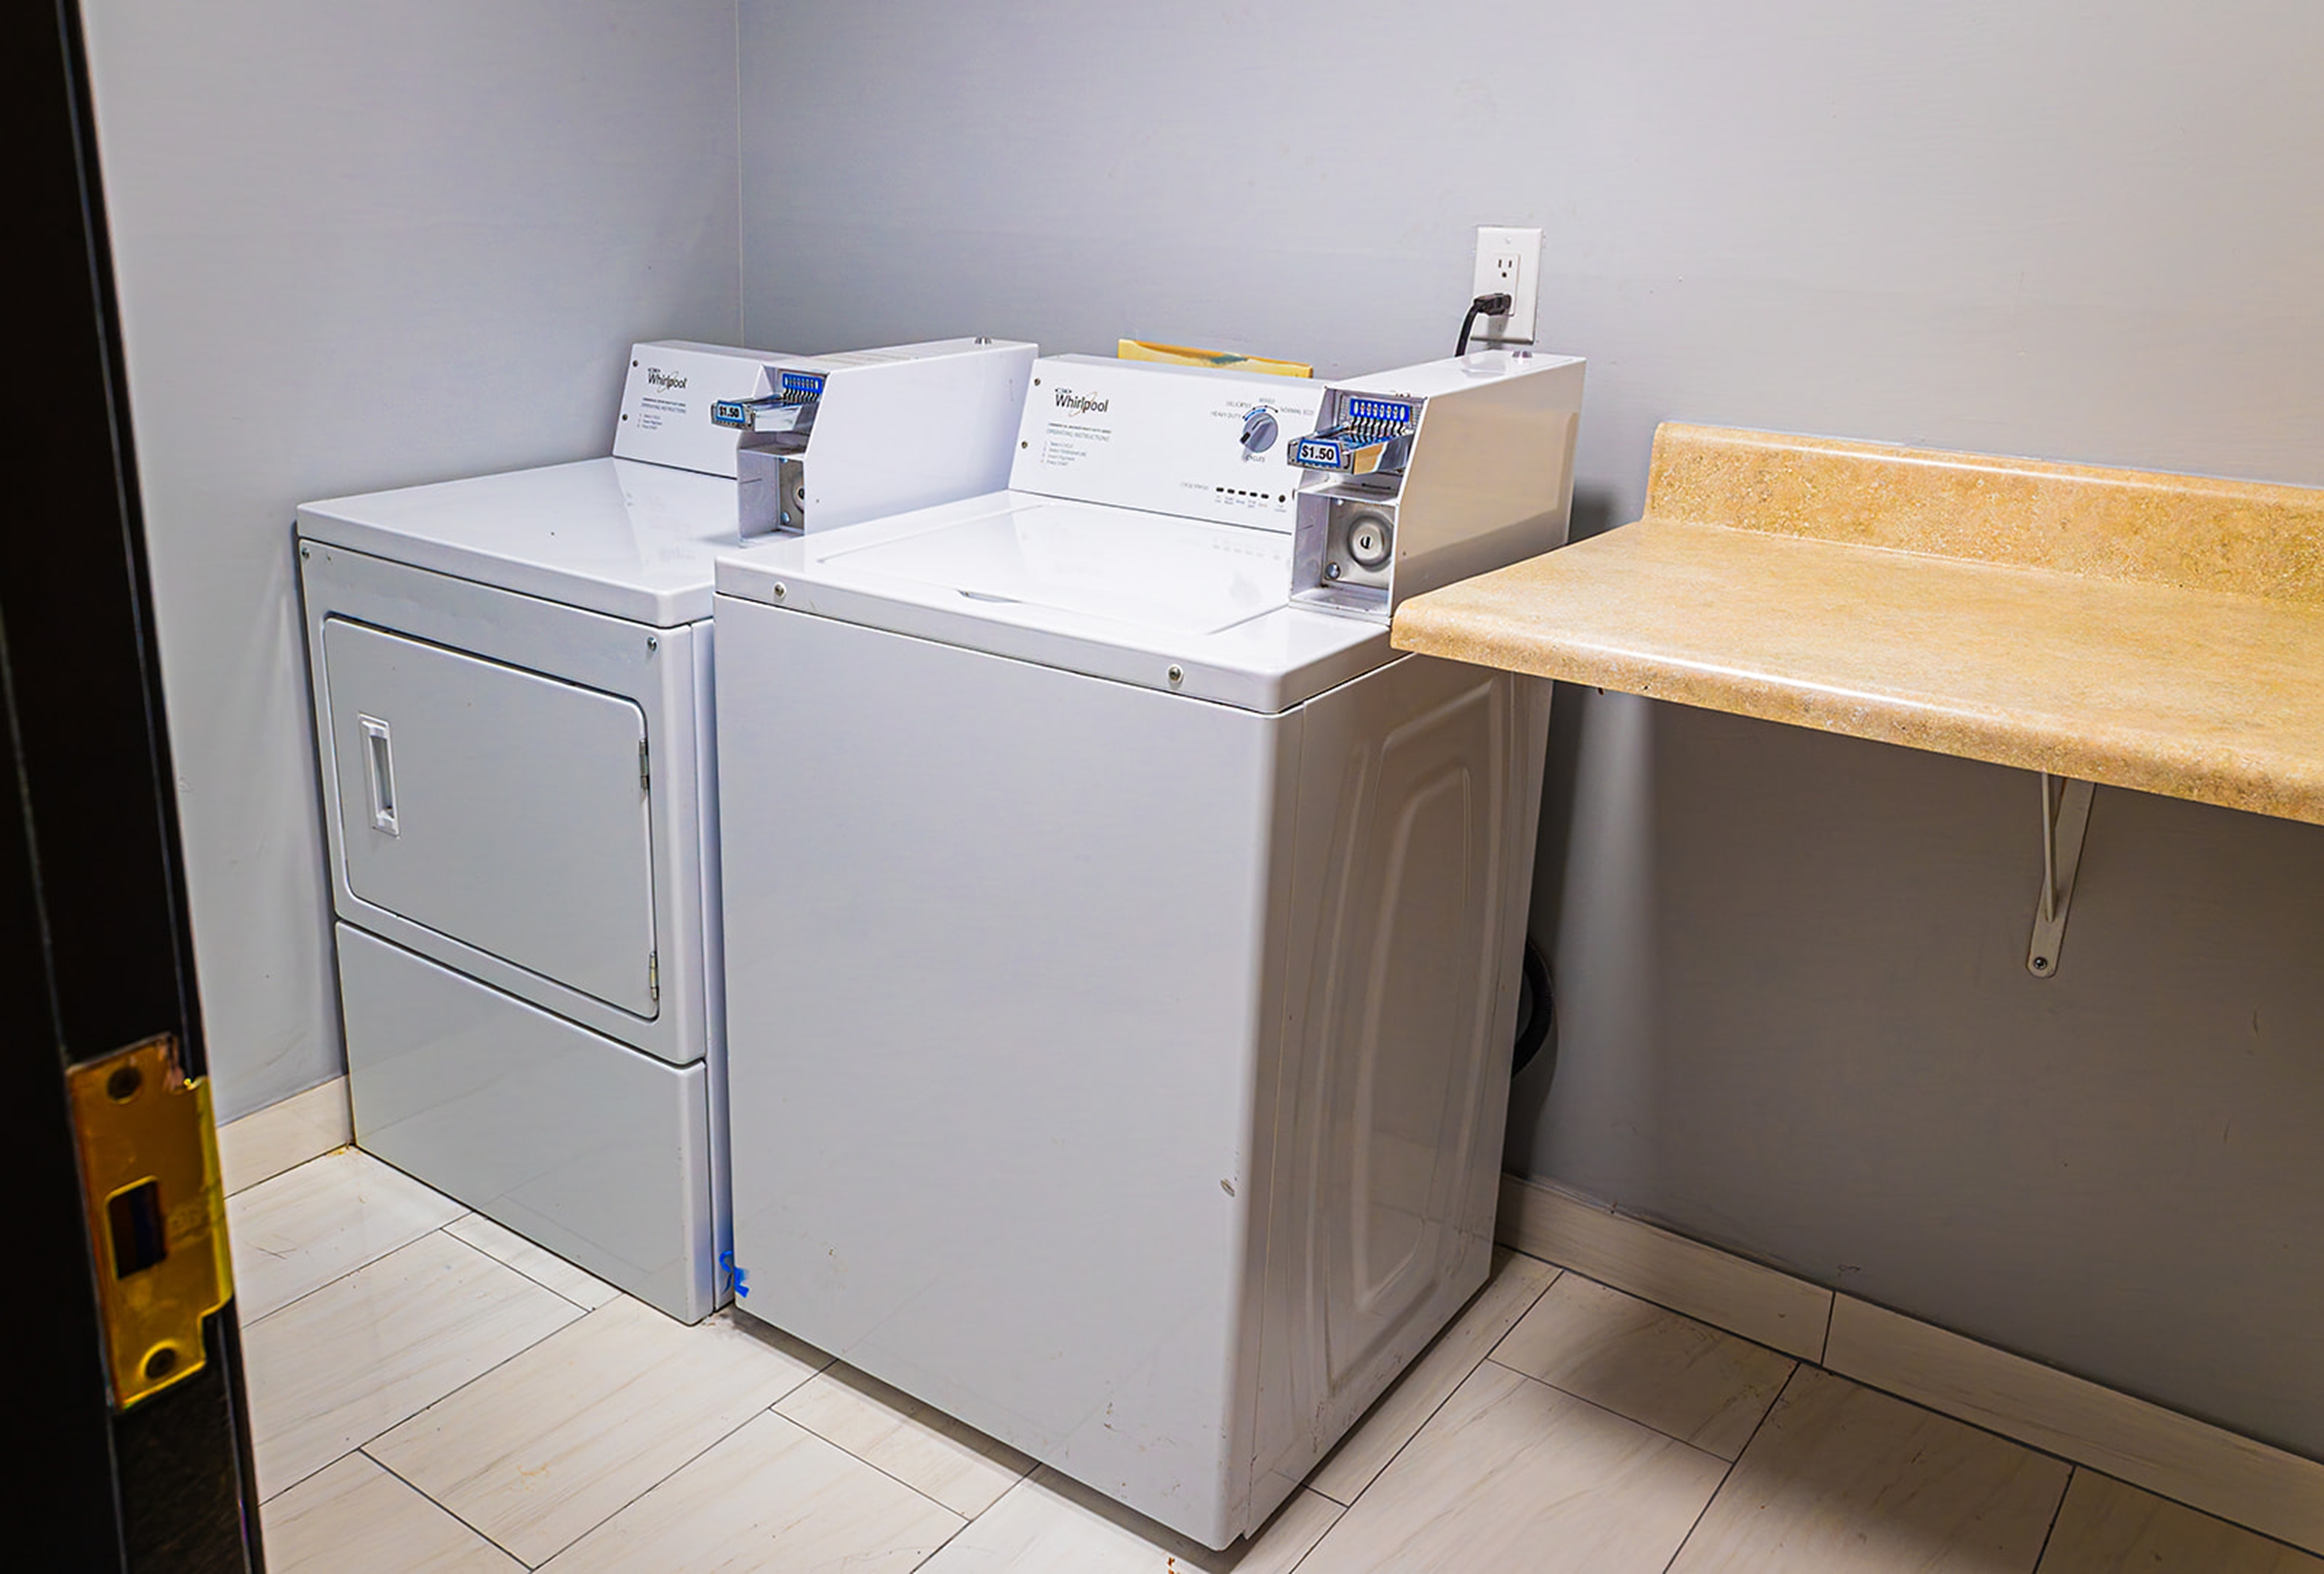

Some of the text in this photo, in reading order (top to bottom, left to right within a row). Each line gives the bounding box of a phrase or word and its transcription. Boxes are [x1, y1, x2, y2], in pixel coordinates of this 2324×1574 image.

[648, 373, 687, 389] Whirlpool
[720, 405, 740, 417] $1.50
[1056, 394, 1109, 414] Whirlpool
[1301, 444, 1334, 460] $1.50
